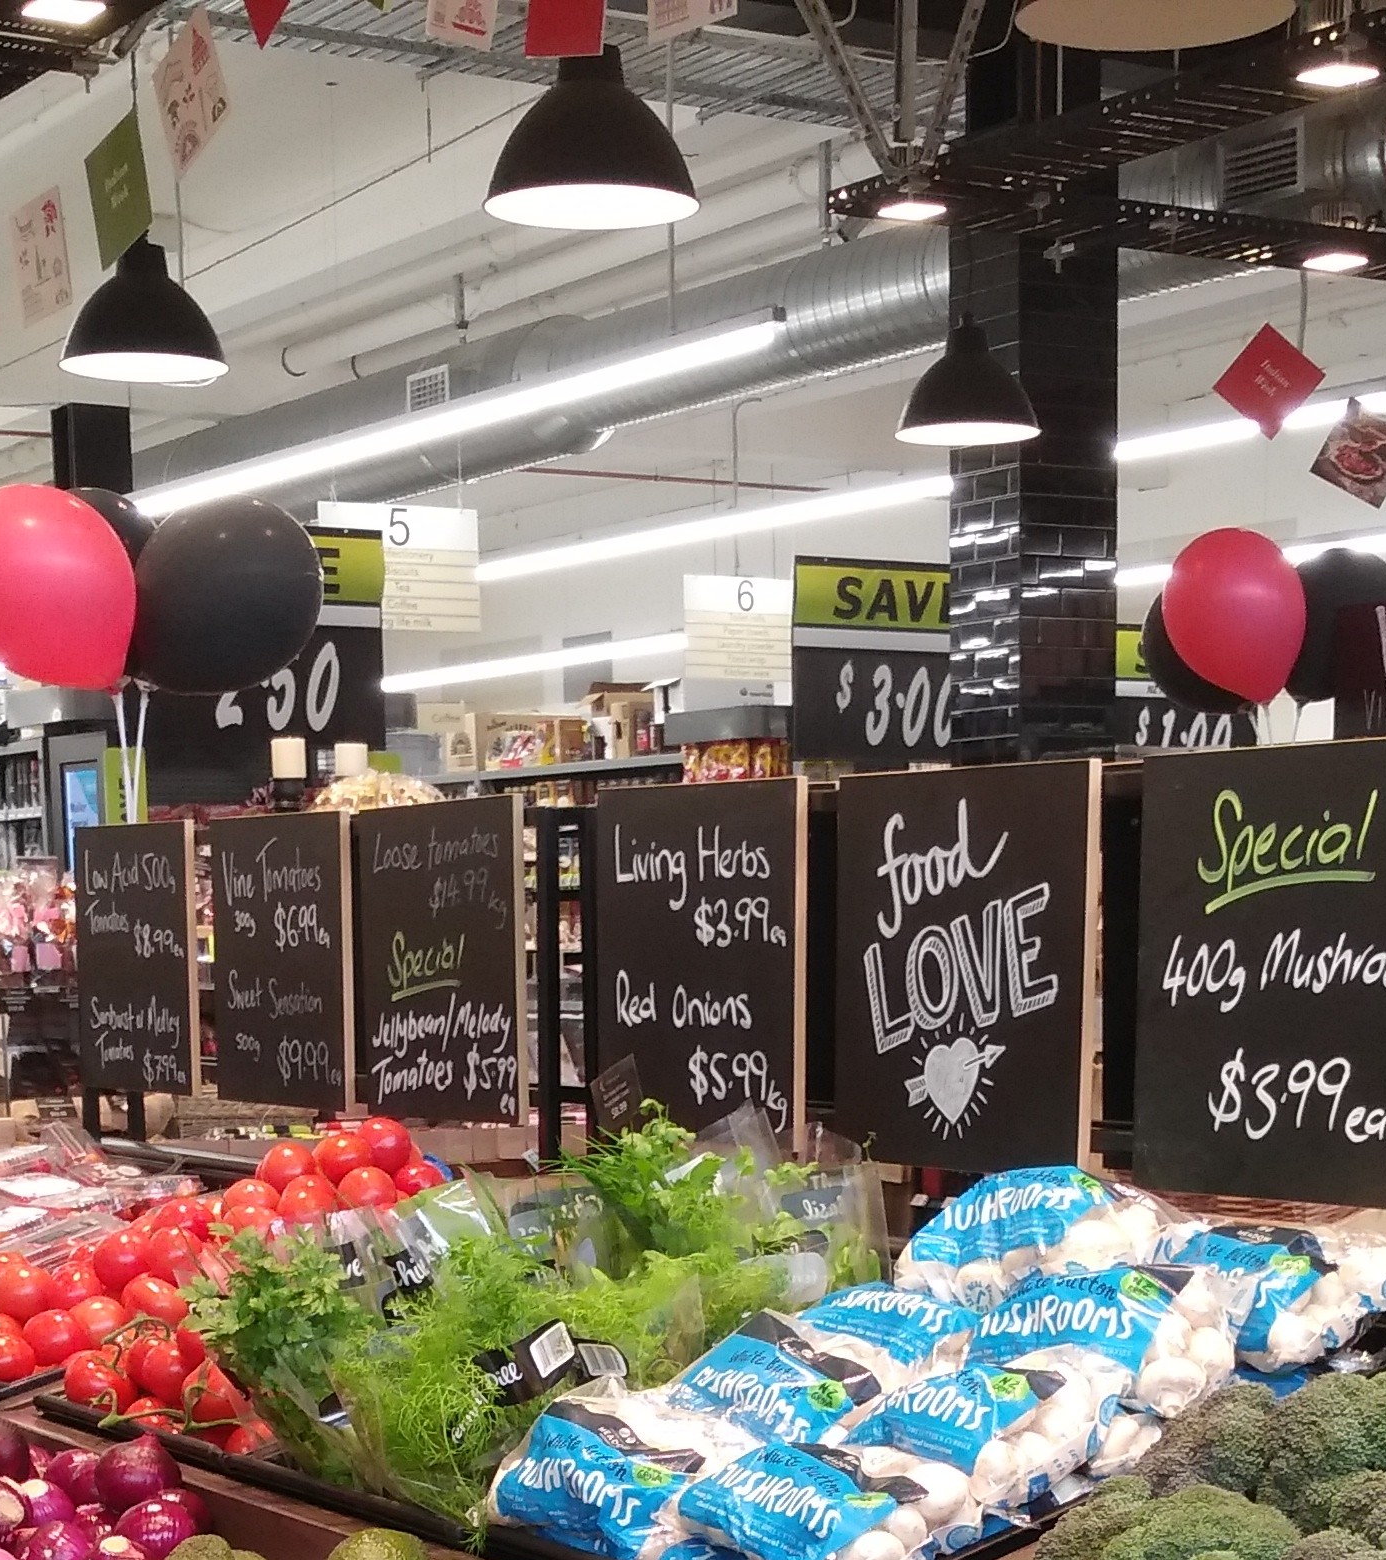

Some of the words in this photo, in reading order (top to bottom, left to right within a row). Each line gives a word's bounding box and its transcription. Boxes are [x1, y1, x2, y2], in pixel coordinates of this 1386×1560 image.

[388, 507, 411, 547] 5
[737, 580, 754, 612] 6
[221, 852, 256, 906] Vine
[255, 837, 322, 901] Tomatoes
[371, 833, 423, 873] Loose
[615, 823, 688, 911] Living
[697, 824, 771, 882] Herbs
[876, 797, 1010, 939] food
[1197, 789, 1380, 890] Special
[227, 969, 263, 1011] Sweet
[386, 930, 466, 990] Special
[863, 882, 1060, 1054] LOVE
[1161, 933, 1246, 1014] 400g
[615, 969, 656, 1028] Red
[671, 983, 753, 1030] Onions
[371, 1049, 454, 1106] Tomatoes
[517, 1457, 641, 1527] MUSHROOMS
